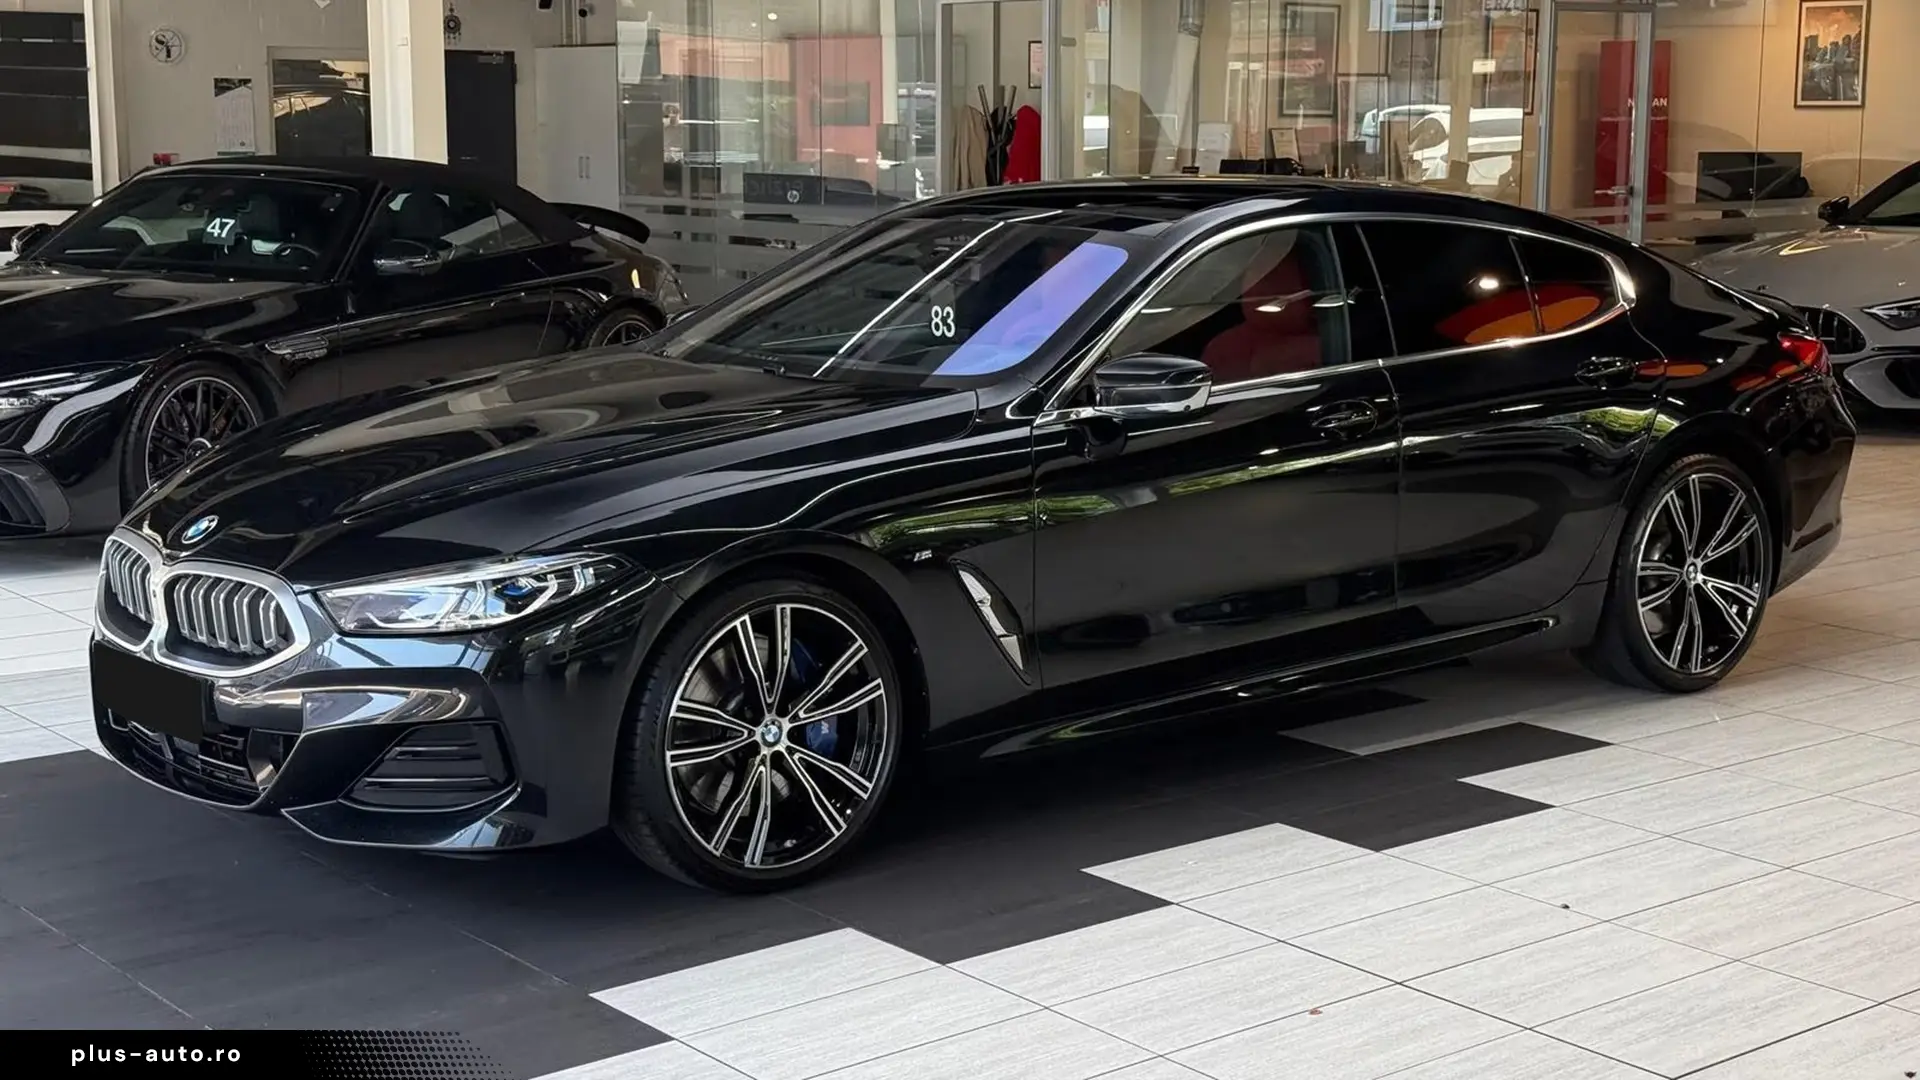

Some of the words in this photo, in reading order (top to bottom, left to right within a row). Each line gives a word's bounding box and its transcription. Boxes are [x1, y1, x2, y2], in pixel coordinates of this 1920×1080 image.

[1627, 97, 1668, 107] NAN
[206, 217, 236, 238] 47
[931, 305, 956, 338] 83
